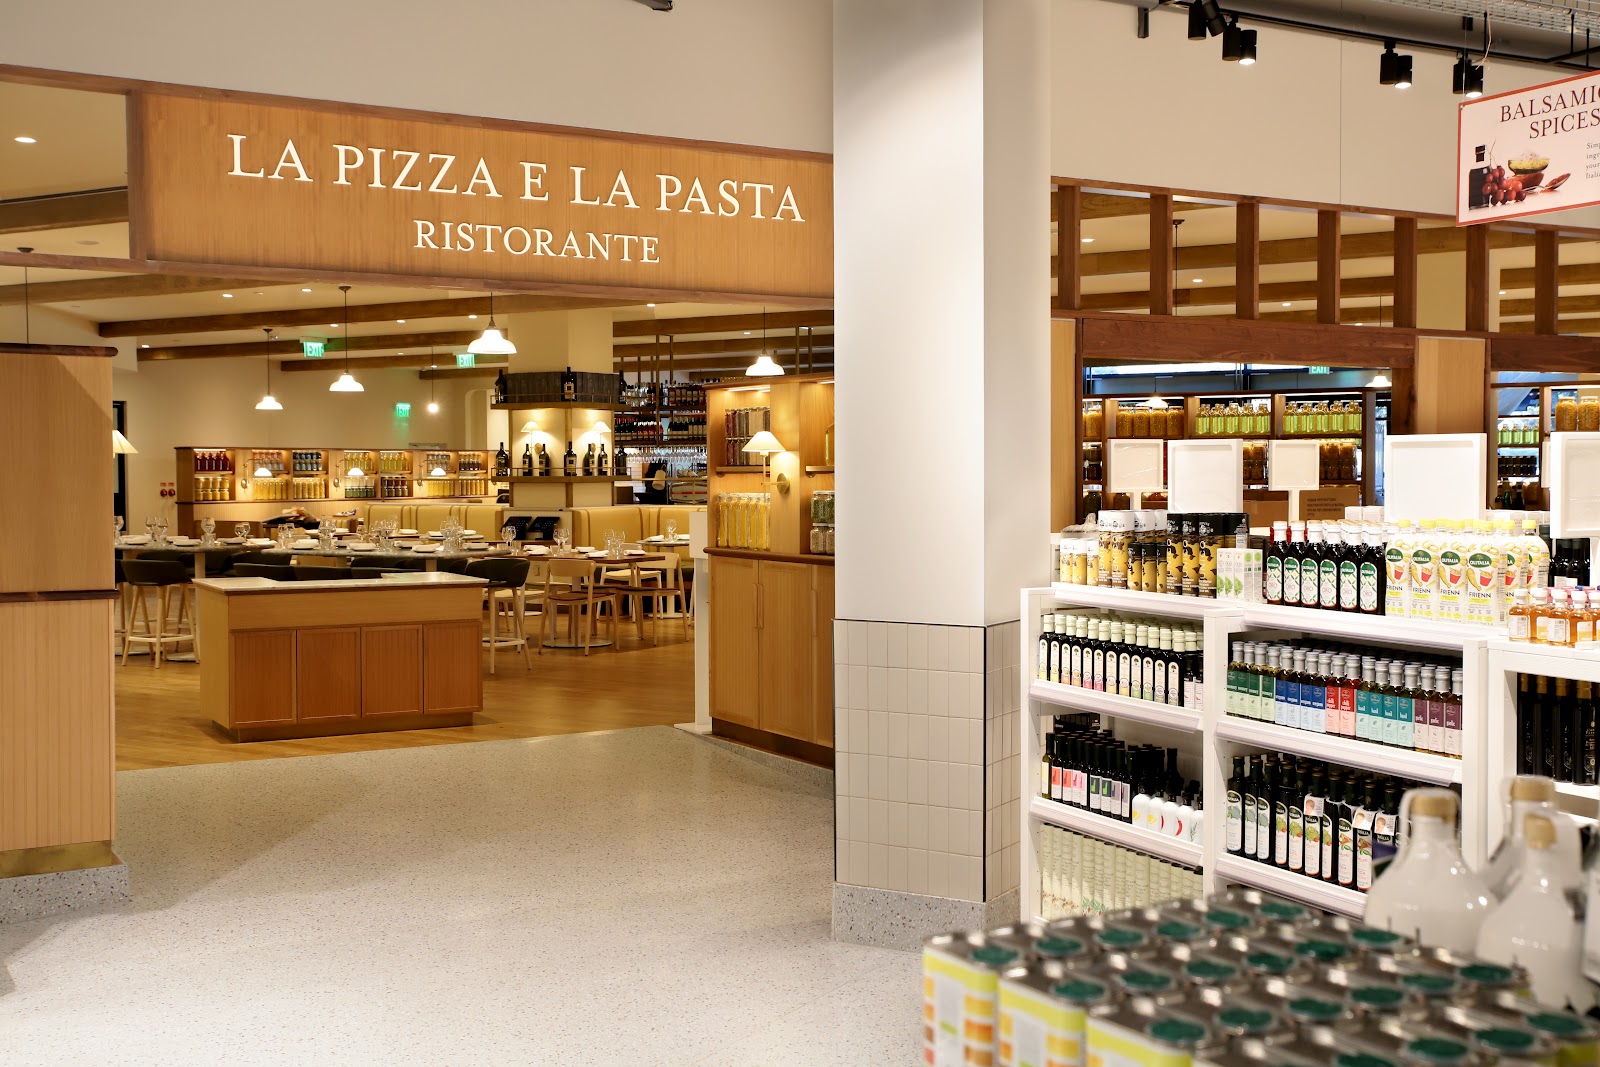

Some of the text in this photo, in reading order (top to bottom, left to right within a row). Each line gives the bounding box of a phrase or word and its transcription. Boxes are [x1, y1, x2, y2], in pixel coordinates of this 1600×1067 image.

[1529, 108, 1600, 140] SPICES
[227, 134, 806, 222] LA PIZZA E LA PASTA
[414, 219, 660, 264] RISTORANTE
[307, 342, 322, 357] EXIT
[459, 354, 473, 368] EXIT
[1311, 365, 1327, 374] EXIT
[399, 405, 410, 418] EXIT
[1469, 591, 1491, 599] FRIENN
